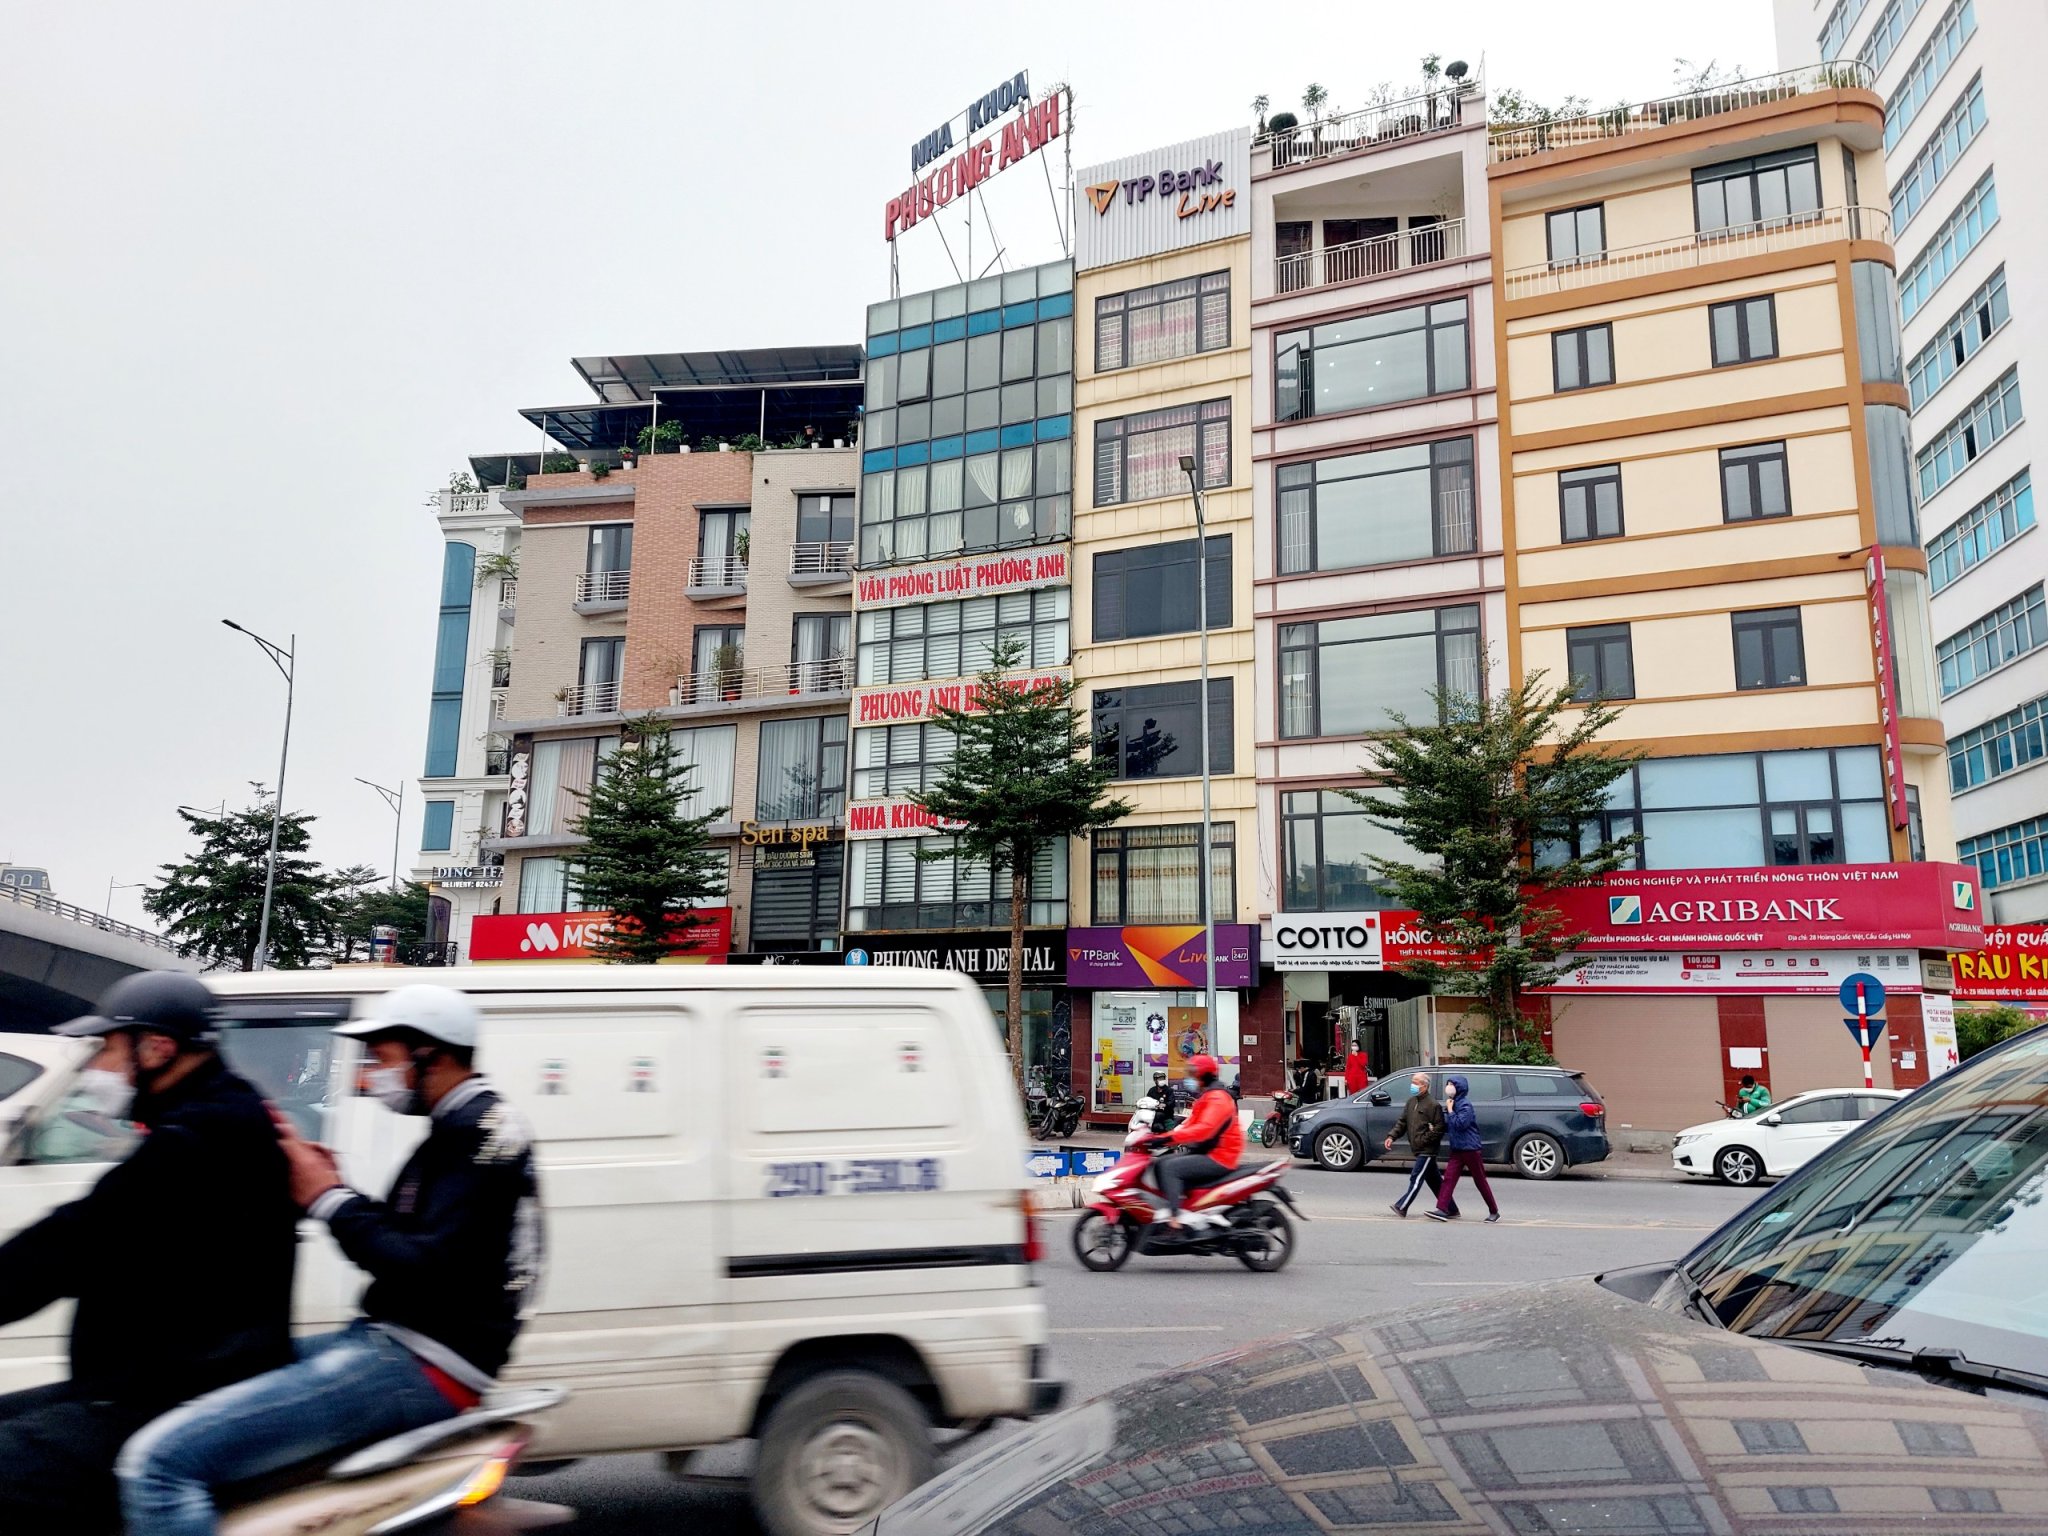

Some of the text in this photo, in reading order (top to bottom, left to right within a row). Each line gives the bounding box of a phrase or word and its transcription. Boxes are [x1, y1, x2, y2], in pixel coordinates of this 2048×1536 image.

[911, 71, 1029, 172] NHA KHOA
[886, 93, 1060, 241] PHƯƠNG ANH
[1122, 158, 1224, 205] TP Bank
[1176, 187, 1237, 220] Live
[859, 553, 1066, 602] VĂN PHÒNG LUẬT PHƯƠNG ANH
[859, 689, 923, 722] PHUONG
[926, 686, 961, 718] ANH
[964, 679, 1029, 712] BETY
[850, 805, 887, 831] NHA
[891, 803, 939, 828] KHOA
[741, 819, 829, 852] Sen spa
[437, 867, 473, 878] DING
[1609, 876, 1640, 887] NÔNG
[1643, 874, 1682, 887] NGHIỆP
[1686, 874, 1701, 885] VÀ
[1704, 873, 1732, 884] PHÁT
[1735, 871, 1769, 883] TRIỂN
[1772, 872, 1804, 882] NÔNG
[1807, 871, 1839, 882] THÔN
[1842, 870, 1868, 882] VIỆT
[1871, 870, 1899, 880] NAM
[1646, 898, 1844, 924] AGRIBANK
[1276, 925, 1369, 950] COTTO
[1658, 934, 1671, 942] CHI
[1672, 932, 1697, 942] NHÁNH
[1697, 932, 1723, 942] HOÀNG
[1724, 931, 1746, 942] QUỐC
[1746, 932, 1764, 942] VIỆT
[1948, 922, 1982, 934] AGRIBANK
[944, 949, 980, 973] ANH
[985, 947, 1056, 972] DETAL
[1083, 949, 1120, 961] TPBank
[1214, 955, 1230, 963] ANK
